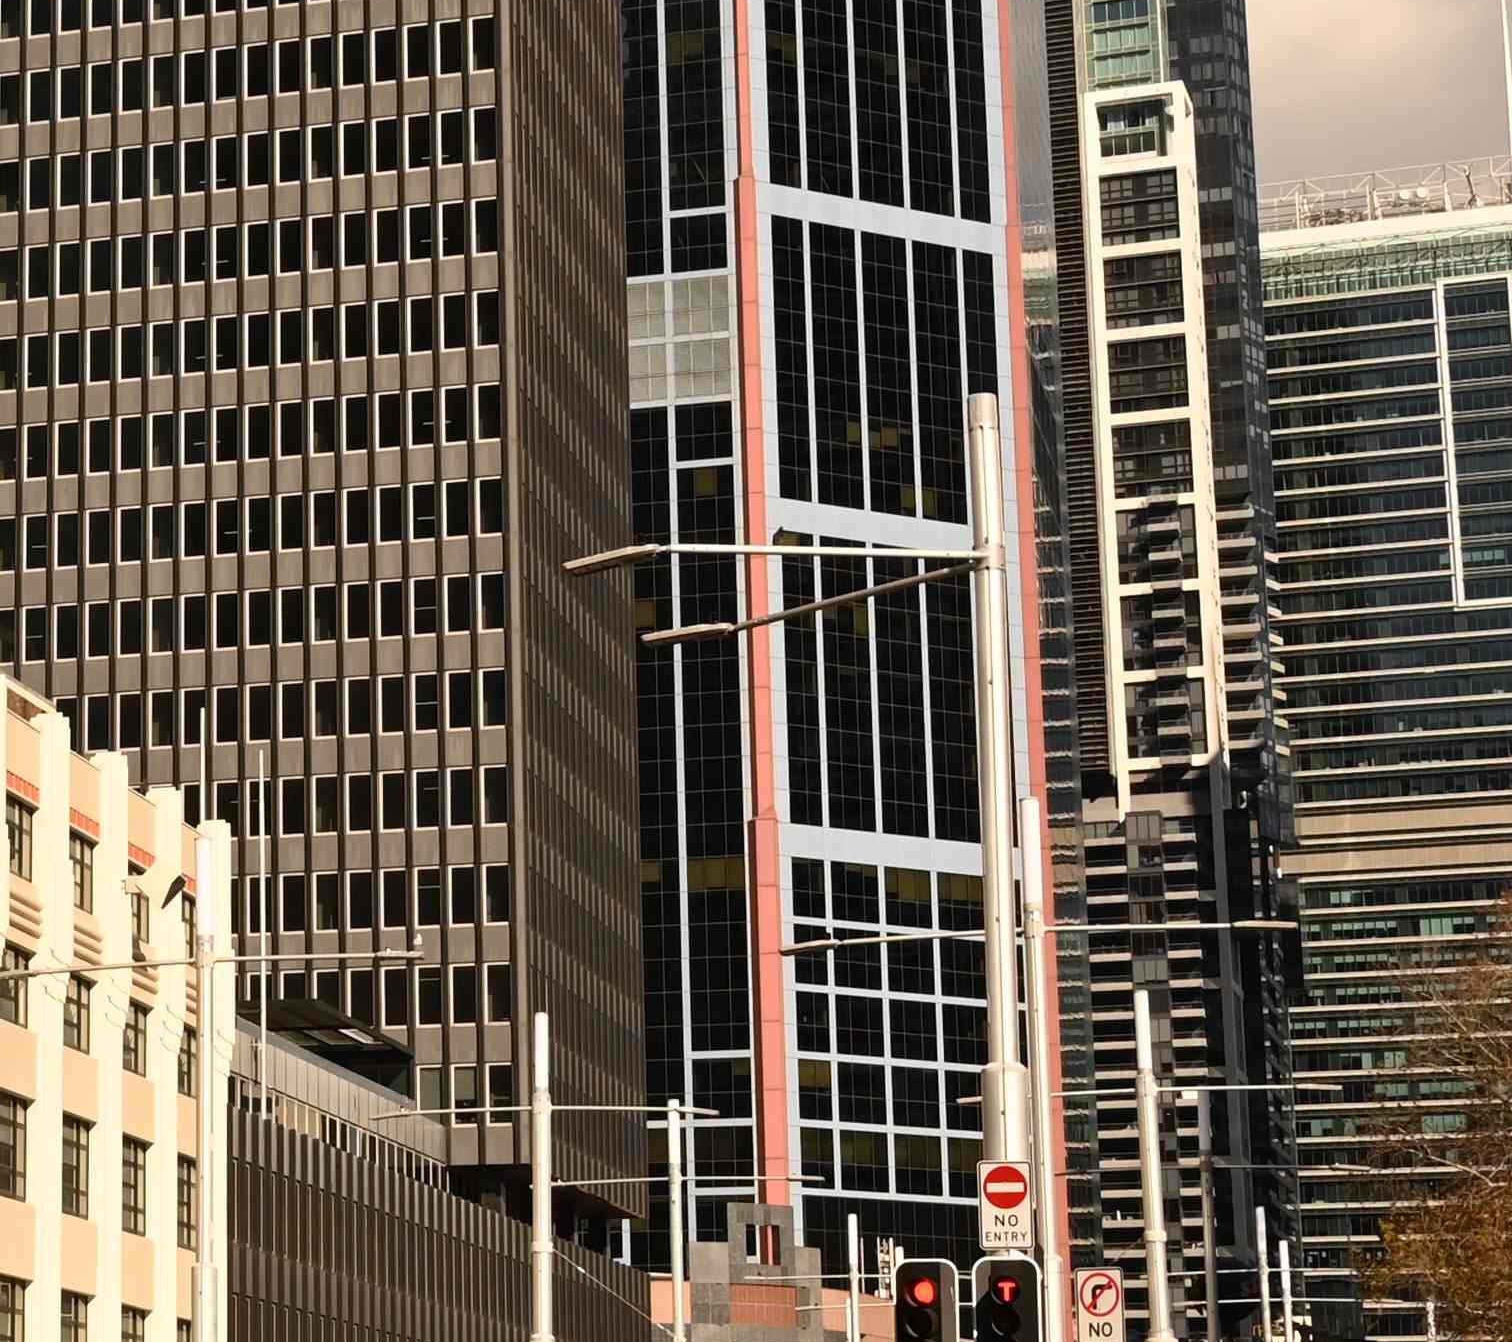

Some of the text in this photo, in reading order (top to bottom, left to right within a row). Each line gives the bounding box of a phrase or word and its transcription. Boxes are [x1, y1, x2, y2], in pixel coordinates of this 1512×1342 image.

[993, 1214, 1018, 1227] NO
[985, 1231, 1028, 1243] ENTRY
[1088, 1322, 1113, 1338] NO
